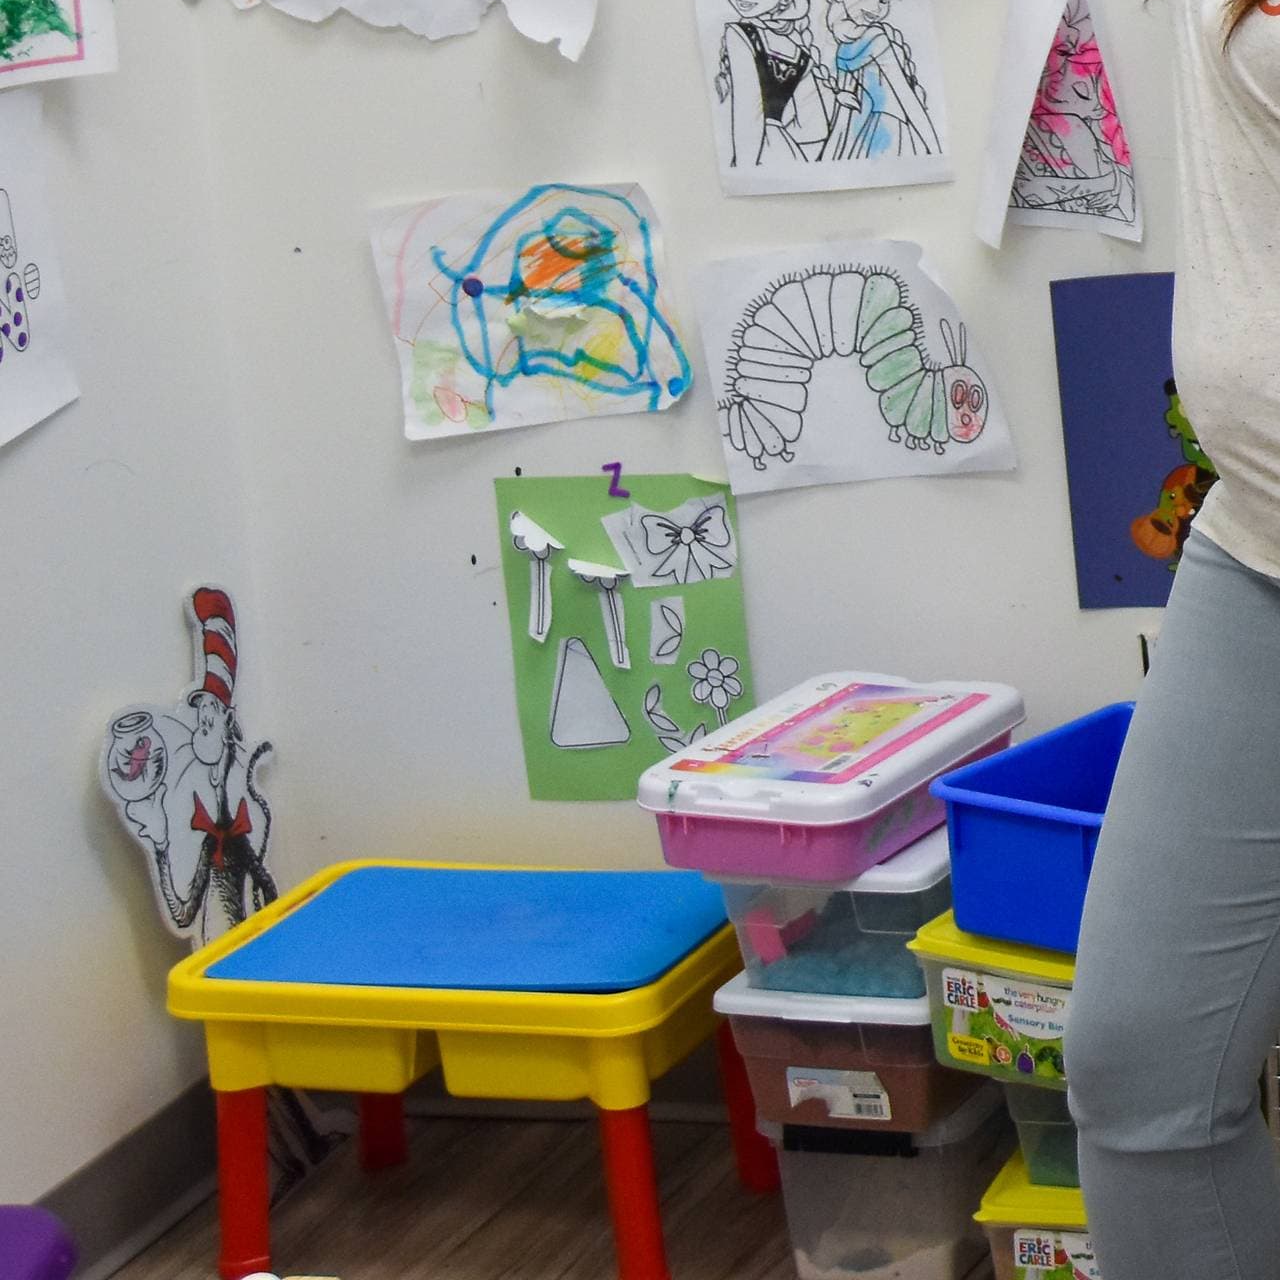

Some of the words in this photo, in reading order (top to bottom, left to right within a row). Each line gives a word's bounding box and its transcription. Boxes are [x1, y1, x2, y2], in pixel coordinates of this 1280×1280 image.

[946, 979, 975, 997] ERIC
[947, 992, 977, 1009] CARLE
[1019, 1239, 1051, 1255] ERIC
[1018, 1253, 1053, 1267] CARLE
